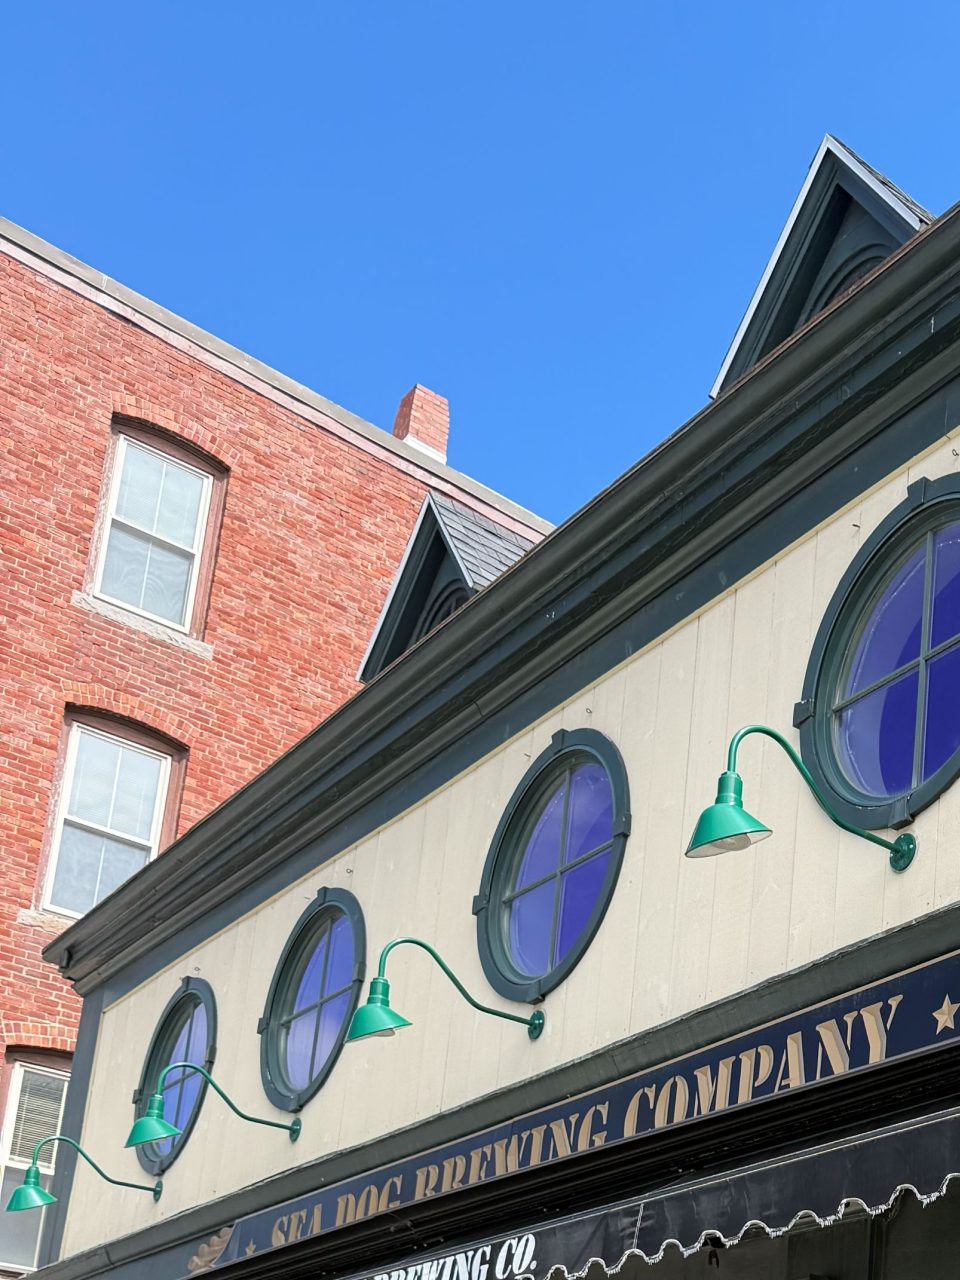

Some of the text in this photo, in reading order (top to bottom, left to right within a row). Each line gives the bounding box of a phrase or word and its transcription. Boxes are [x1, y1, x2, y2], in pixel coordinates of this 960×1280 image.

[271, 994, 904, 1248] SEA DOG BREWING COMPANY
[494, 1233, 538, 1280] CO.
